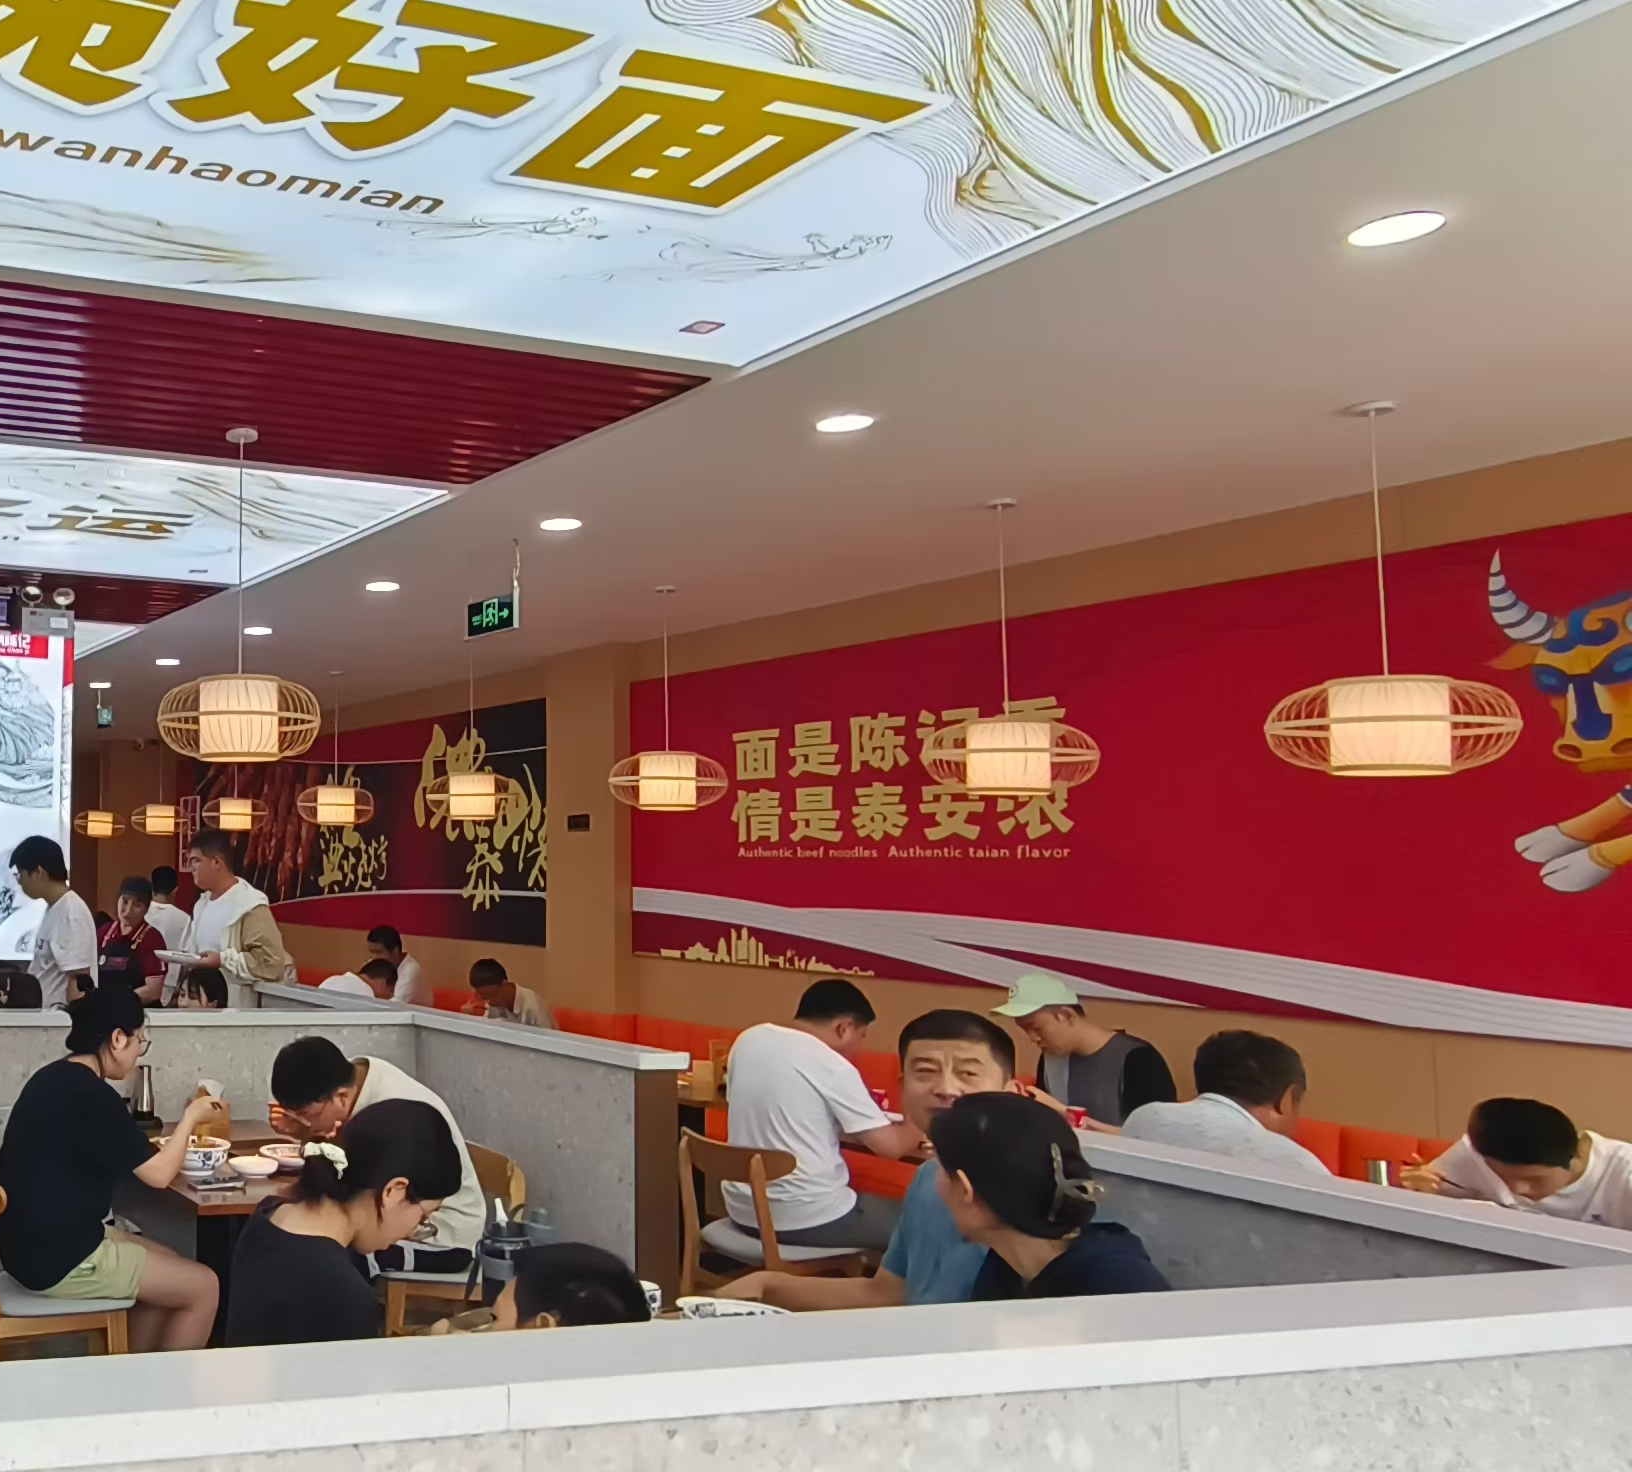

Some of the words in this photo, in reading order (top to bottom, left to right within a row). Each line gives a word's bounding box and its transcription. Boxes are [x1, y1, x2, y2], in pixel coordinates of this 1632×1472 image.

[737, 845, 794, 859] Authentic
[796, 845, 824, 858] beef
[828, 845, 879, 859] noodles
[887, 845, 963, 859] Authentic
[968, 844, 1010, 859] taian
[1016, 844, 1071, 859] flavor
